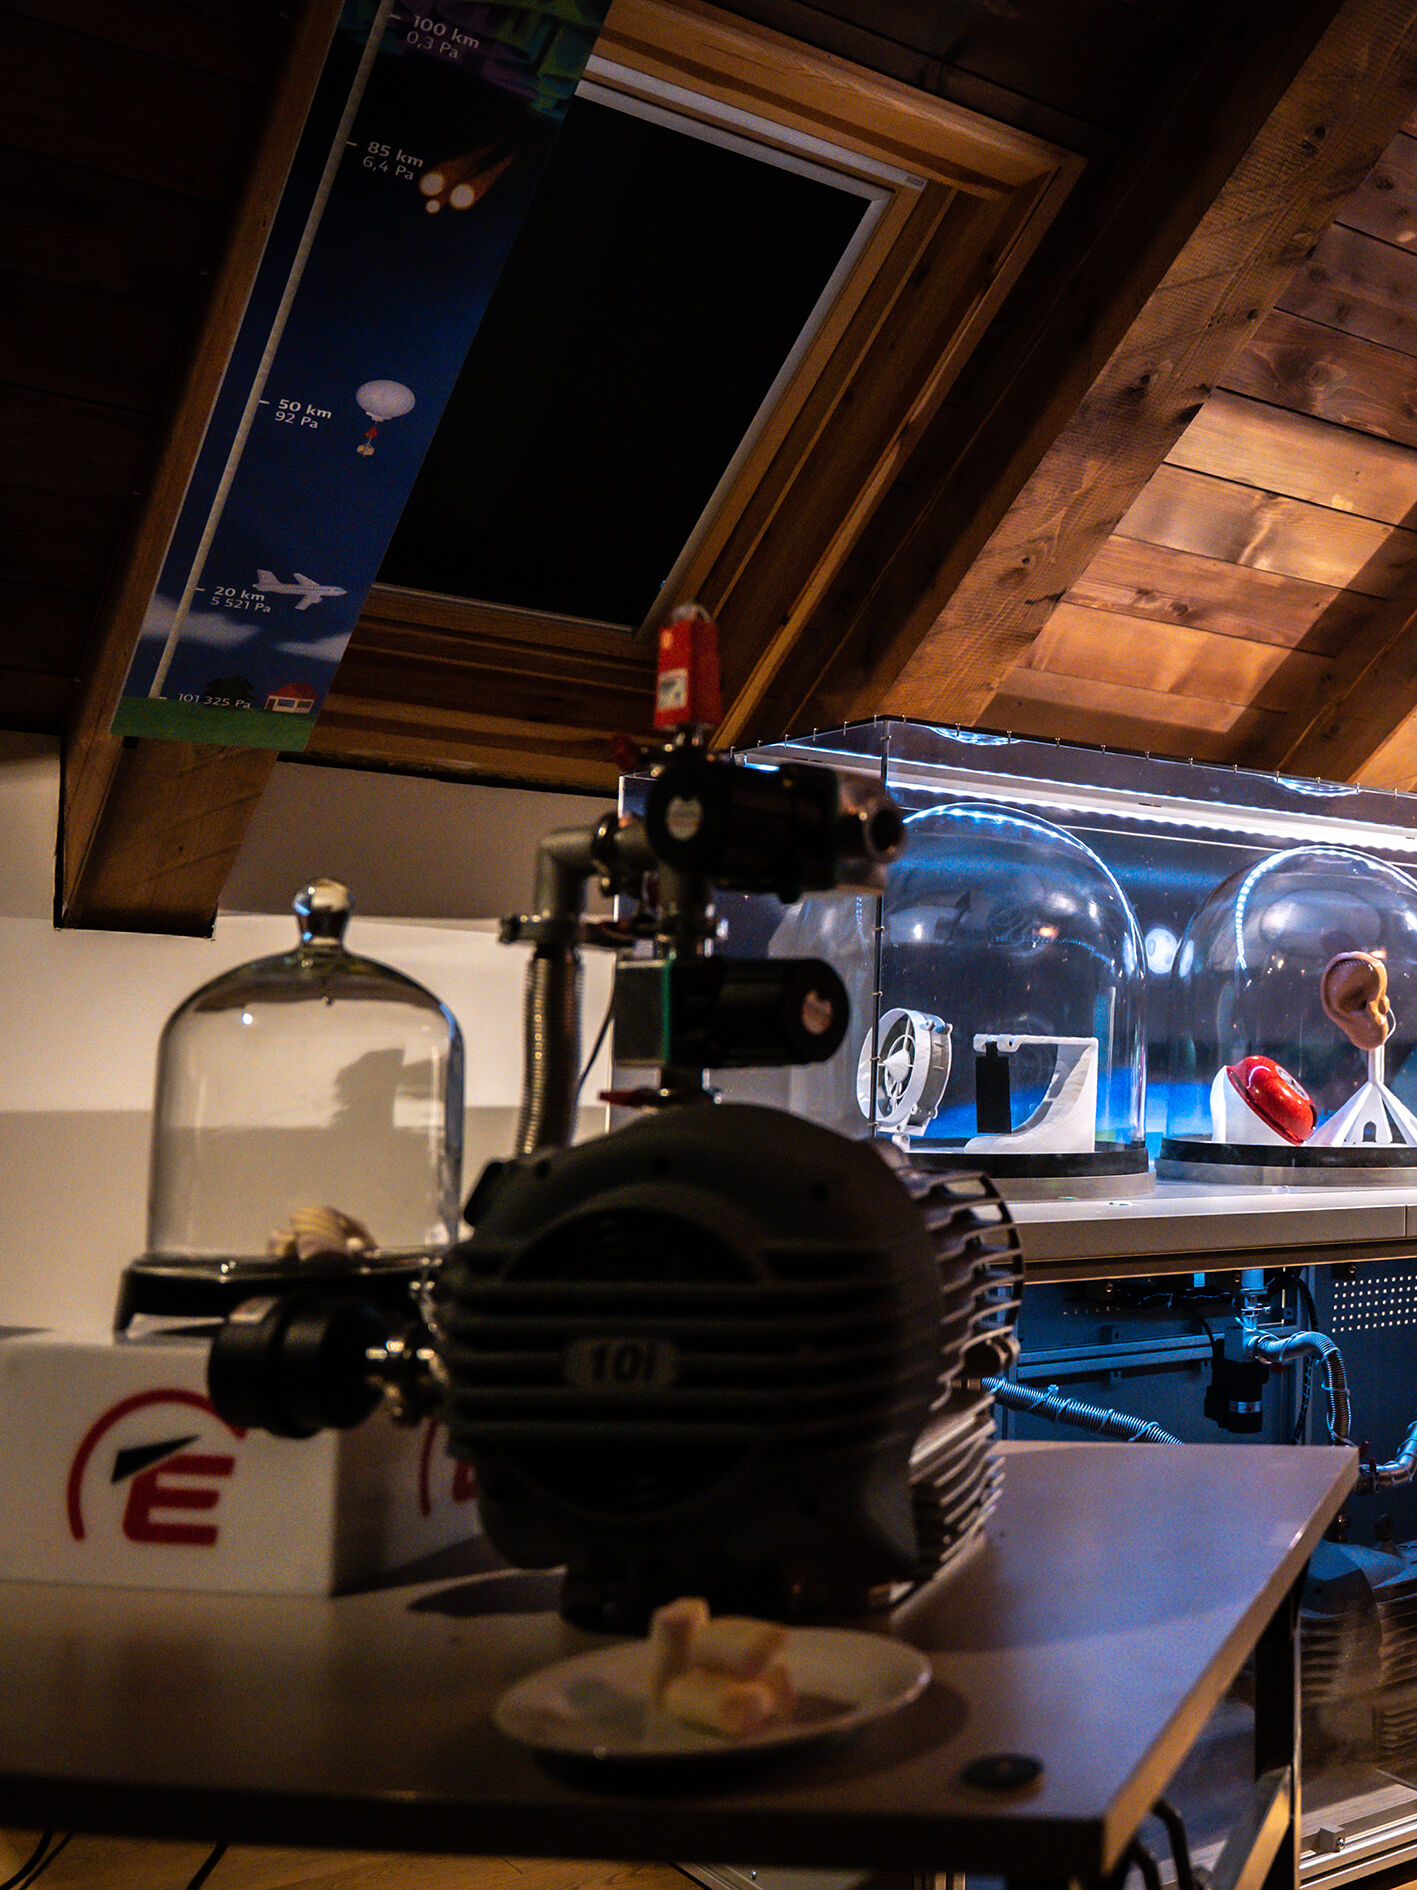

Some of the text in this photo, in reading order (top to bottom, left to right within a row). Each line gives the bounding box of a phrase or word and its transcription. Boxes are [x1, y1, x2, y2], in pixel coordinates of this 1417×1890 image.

[413, 14, 480, 48] 100 km
[406, 30, 458, 58] 0,3 Pa
[367, 141, 424, 167] 85 km
[362, 155, 414, 180] 6,4 Pa
[278, 398, 332, 419] 50 km
[275, 410, 318, 429] 92 Pa
[213, 585, 265, 601] 20 km
[210, 596, 271, 613] 5 521 Pa
[179, 693, 251, 709] 101 325 Pa
